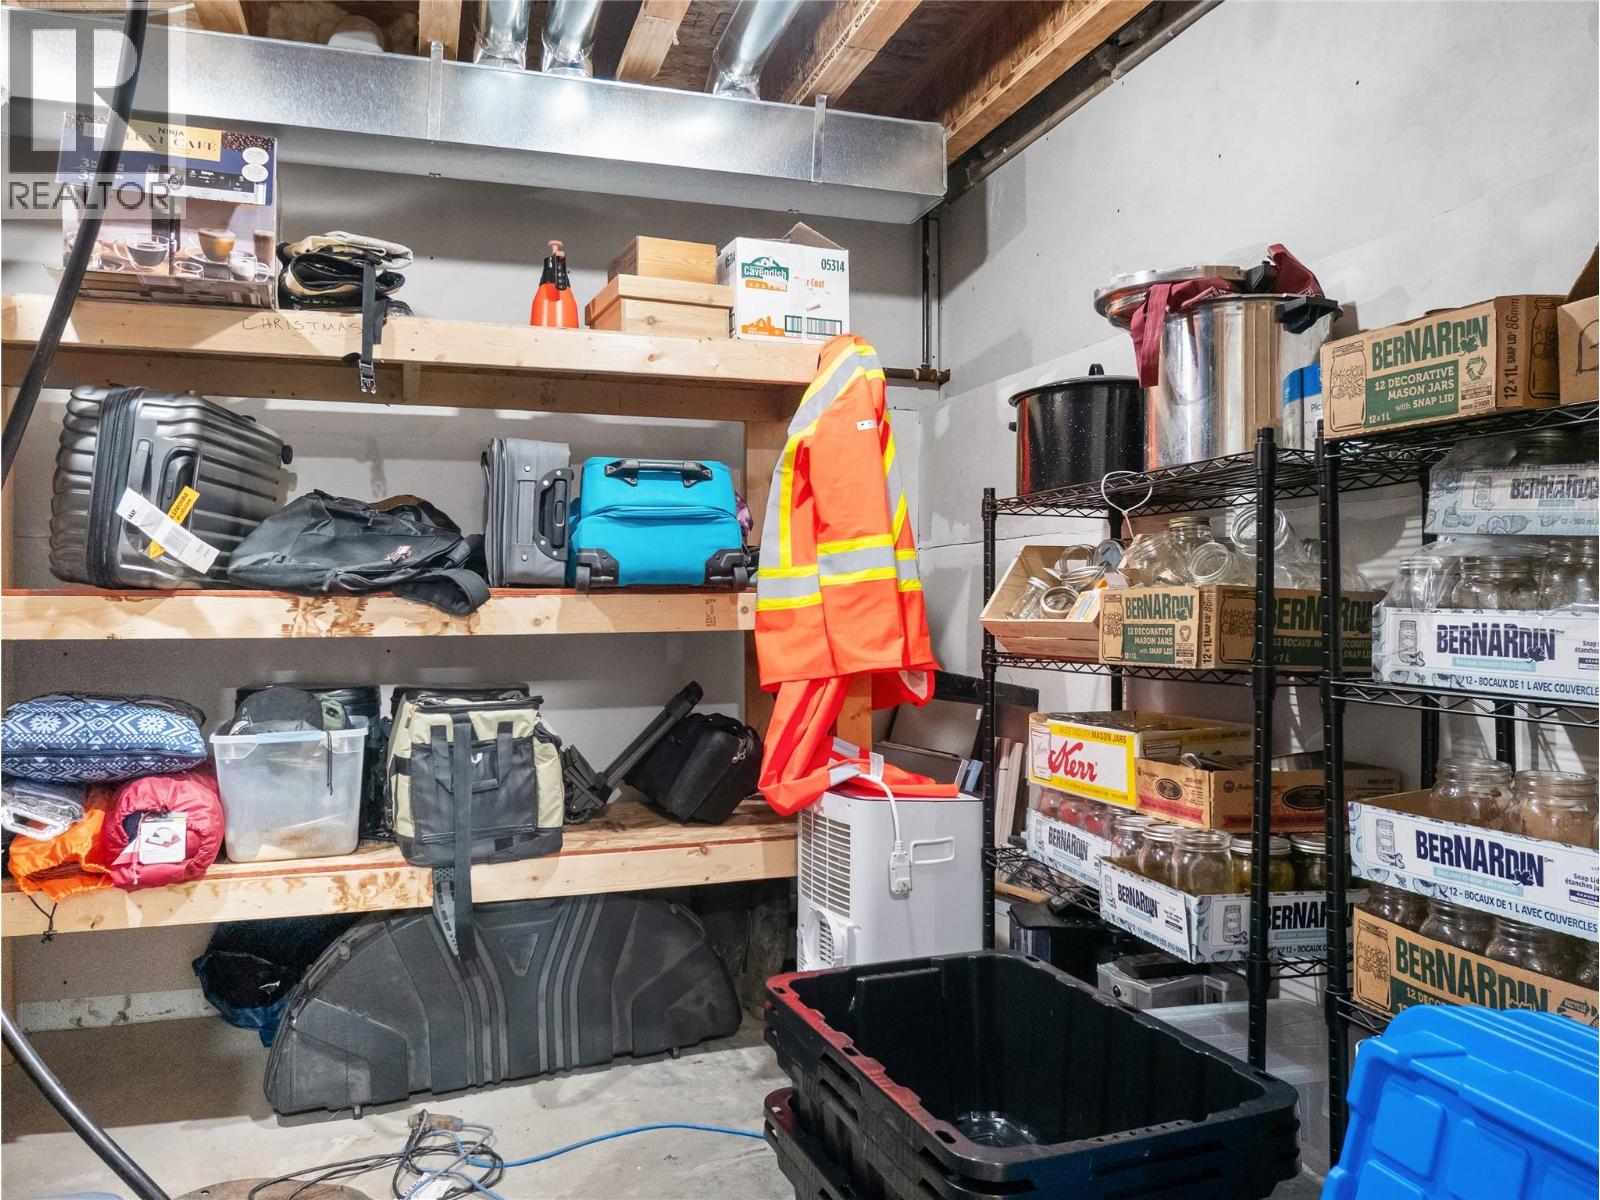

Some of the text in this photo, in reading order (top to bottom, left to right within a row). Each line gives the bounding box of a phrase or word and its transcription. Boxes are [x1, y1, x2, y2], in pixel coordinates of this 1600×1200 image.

[158, 126, 184, 137] NINJA
[744, 266, 787, 280] Cavendish
[821, 258, 845, 272] 05314
[242, 317, 362, 335] CHRISTMAS
[1372, 315, 1488, 371] BERNARDIN
[1507, 346, 1516, 364] SNAP
[1375, 366, 1454, 391] 12 DECORATIVE
[1388, 385, 1425, 400] MASON
[1428, 379, 1454, 393] JARS
[1396, 402, 1411, 411] with
[1412, 397, 1437, 408] SNAP
[1125, 593, 1194, 619] BERNARDIN
[1134, 627, 1173, 635] DECORATIVE
[1134, 637, 1173, 645] MASON JARS
[1437, 622, 1555, 660] BERNARDIN
[1148, 647, 1163, 655] SNAP
[1466, 676, 1472, 684] 12
[1479, 677, 1508, 688] BOCAUX
[1509, 680, 1519, 689] DE
[1533, 682, 1552, 692] AVEC
[1554, 683, 1599, 696] COUVERCLE
[1092, 731, 1112, 741] MASON
[1112, 733, 1127, 744] JARS
[1048, 740, 1097, 782] Kerr
[1049, 826, 1088, 861] BERNARDIN
[1415, 830, 1544, 887] BERNARDIN
[1118, 883, 1158, 918] BERNARDIN
[1449, 887, 1457, 896] 12
[1465, 891, 1495, 905] BOCAUX
[1496, 899, 1506, 909] DE
[1516, 904, 1520, 913] L
[1522, 906, 1543, 918] AVEC
[1545, 909, 1598, 933] COUVERCLES
[1297, 944, 1322, 953] BOCAUX
[1396, 936, 1549, 1012] BERNARDIN
[1407, 987, 1416, 999] 12
